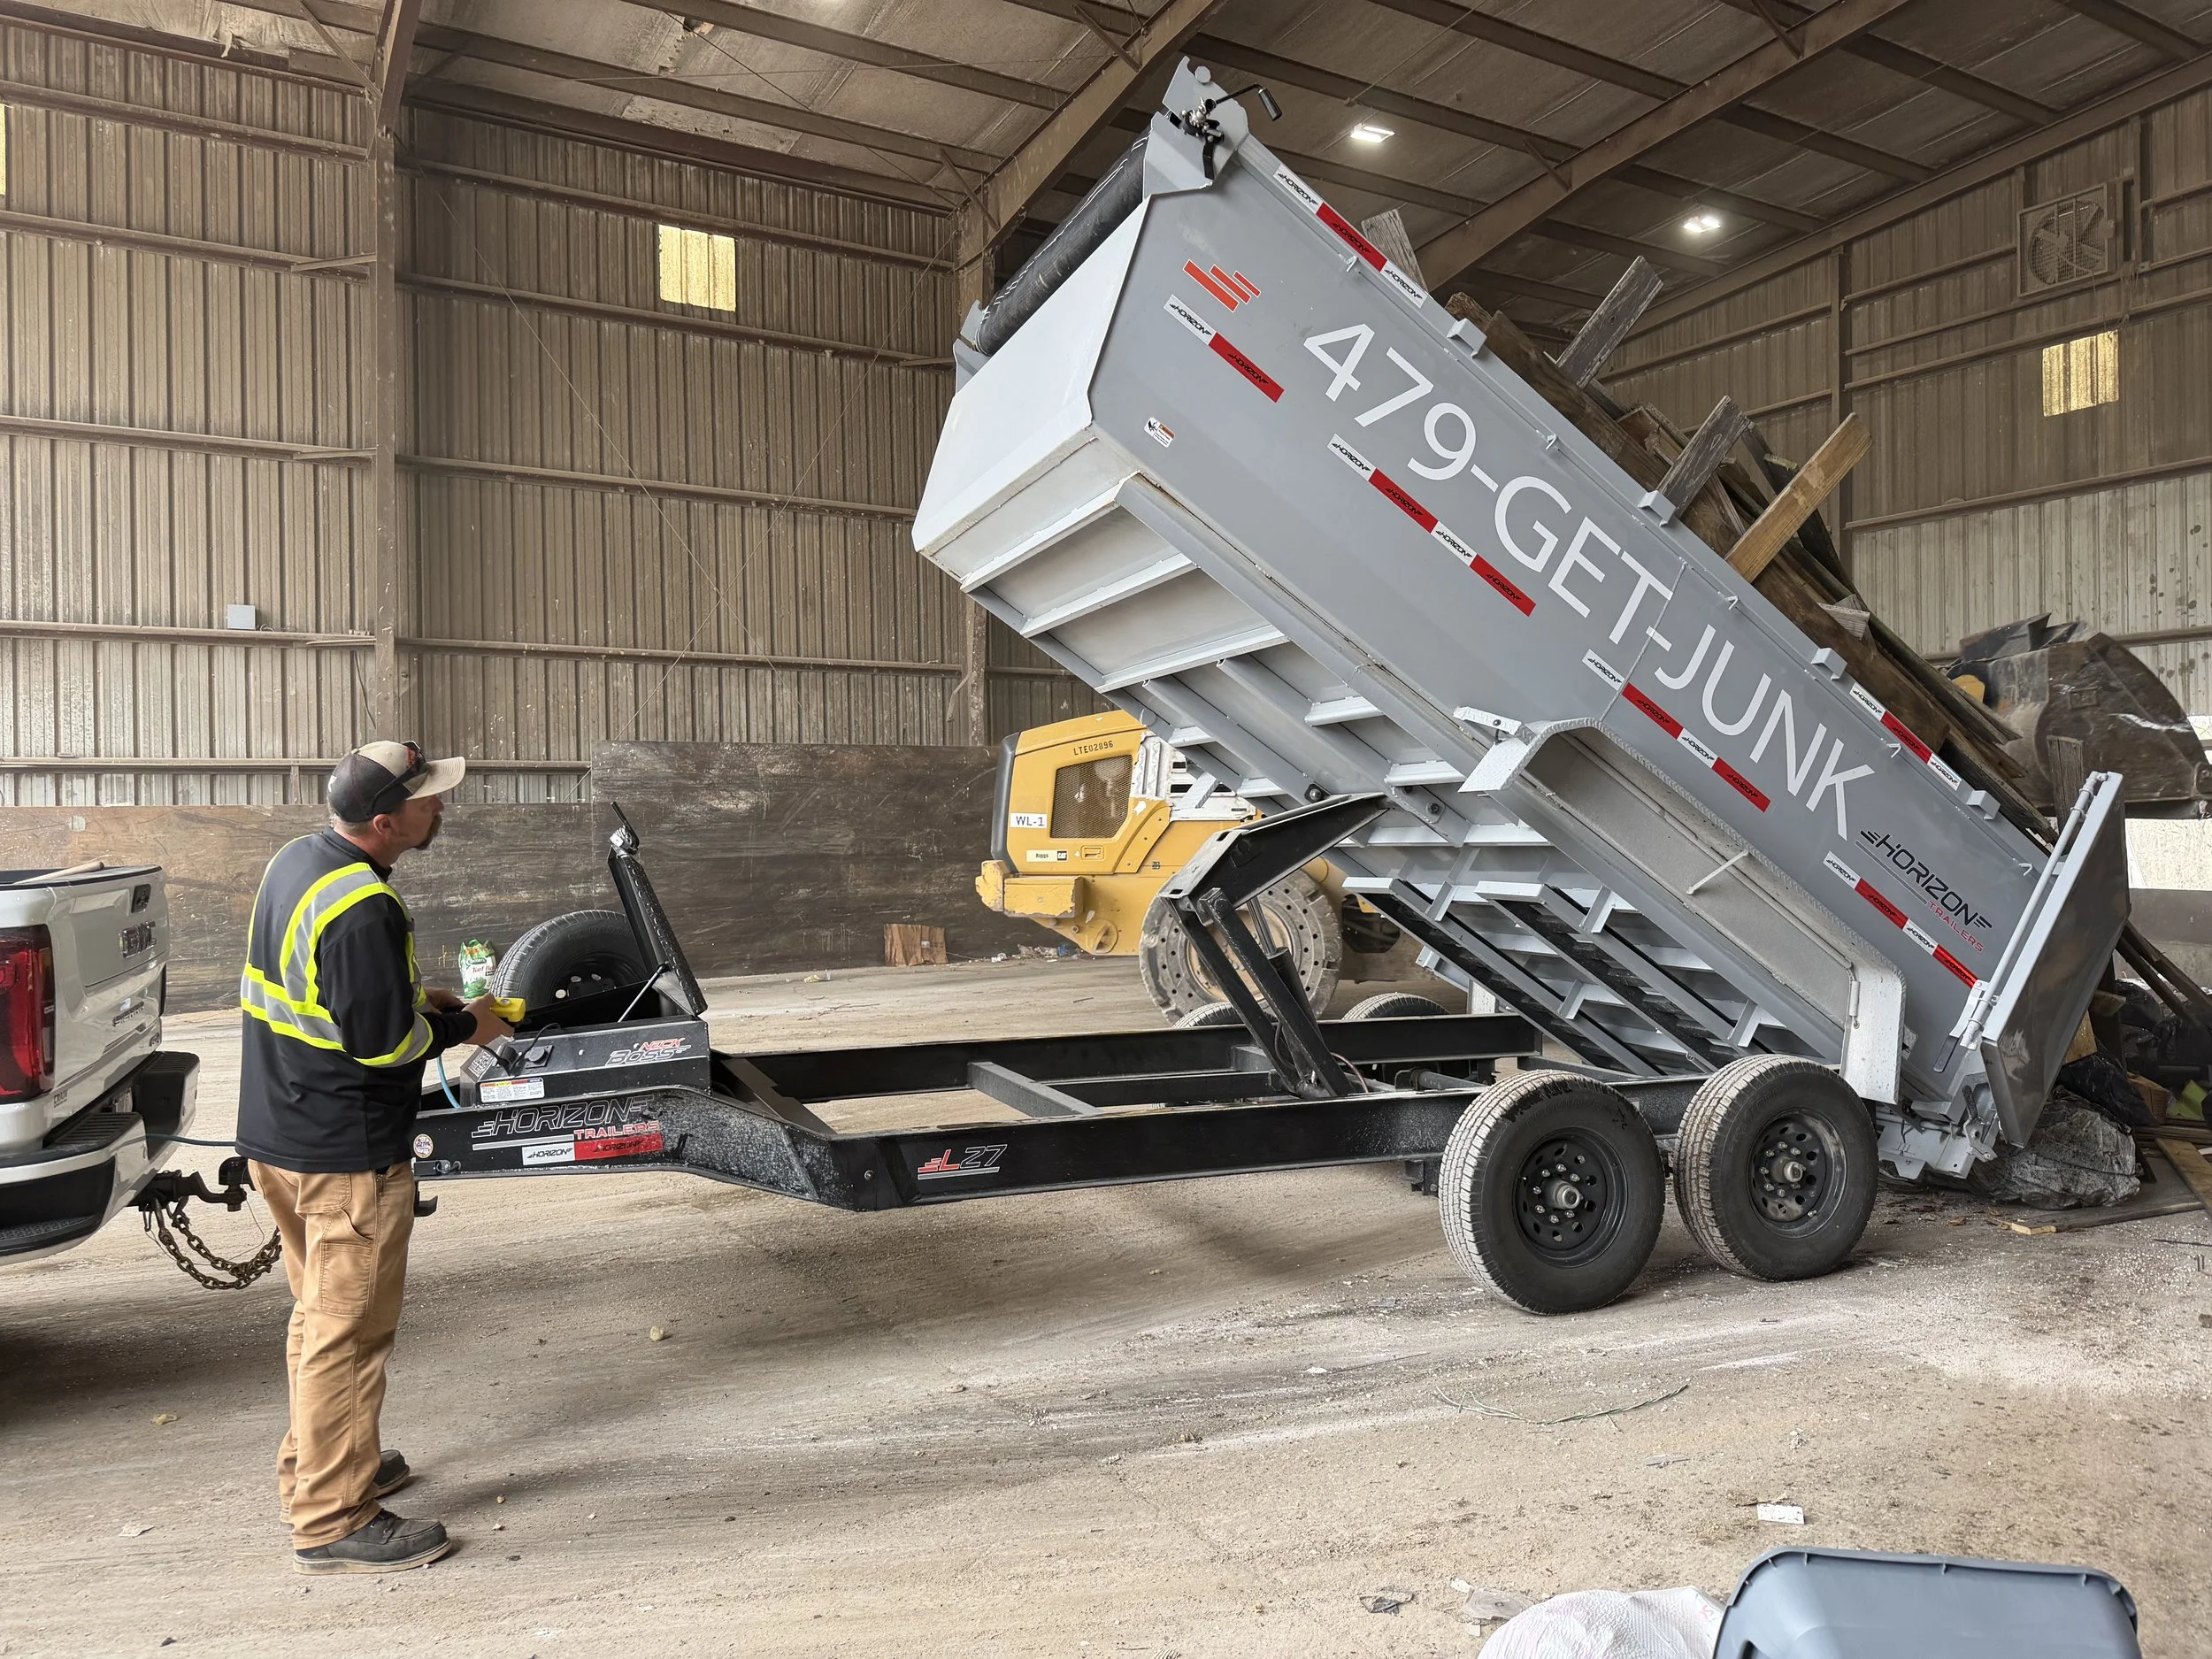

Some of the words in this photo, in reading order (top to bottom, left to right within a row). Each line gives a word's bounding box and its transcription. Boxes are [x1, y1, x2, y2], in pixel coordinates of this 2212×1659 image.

[1279, 173, 1317, 204] HORIZON
[1386, 270, 1422, 299] HORIZON
[1171, 304, 1211, 334] HORIZON
[1333, 443, 1370, 471] HORIZON
[1436, 531, 1471, 557] HORIZON
[1304, 324, 1875, 840] 479-GET-JUNK
[1588, 658, 1621, 683] HORIZON
[1682, 737, 1714, 760] HORIZON
[1854, 691, 1881, 713] HORIZON
[1931, 762, 1957, 783] HORIZON
[1016, 816, 1045, 826] WL-1
[1827, 860, 1855, 880] HORIZON
[1908, 927, 1934, 949] HORIZON
[1867, 831, 1985, 927] HORIZON
[1928, 901, 1984, 953] TRAILERS
[604, 1048, 677, 1066] BOSS
[481, 1095, 643, 1136] HORIZON
[574, 1120, 659, 1140] TRAILERS
[529, 1148, 572, 1158] HORIZON
